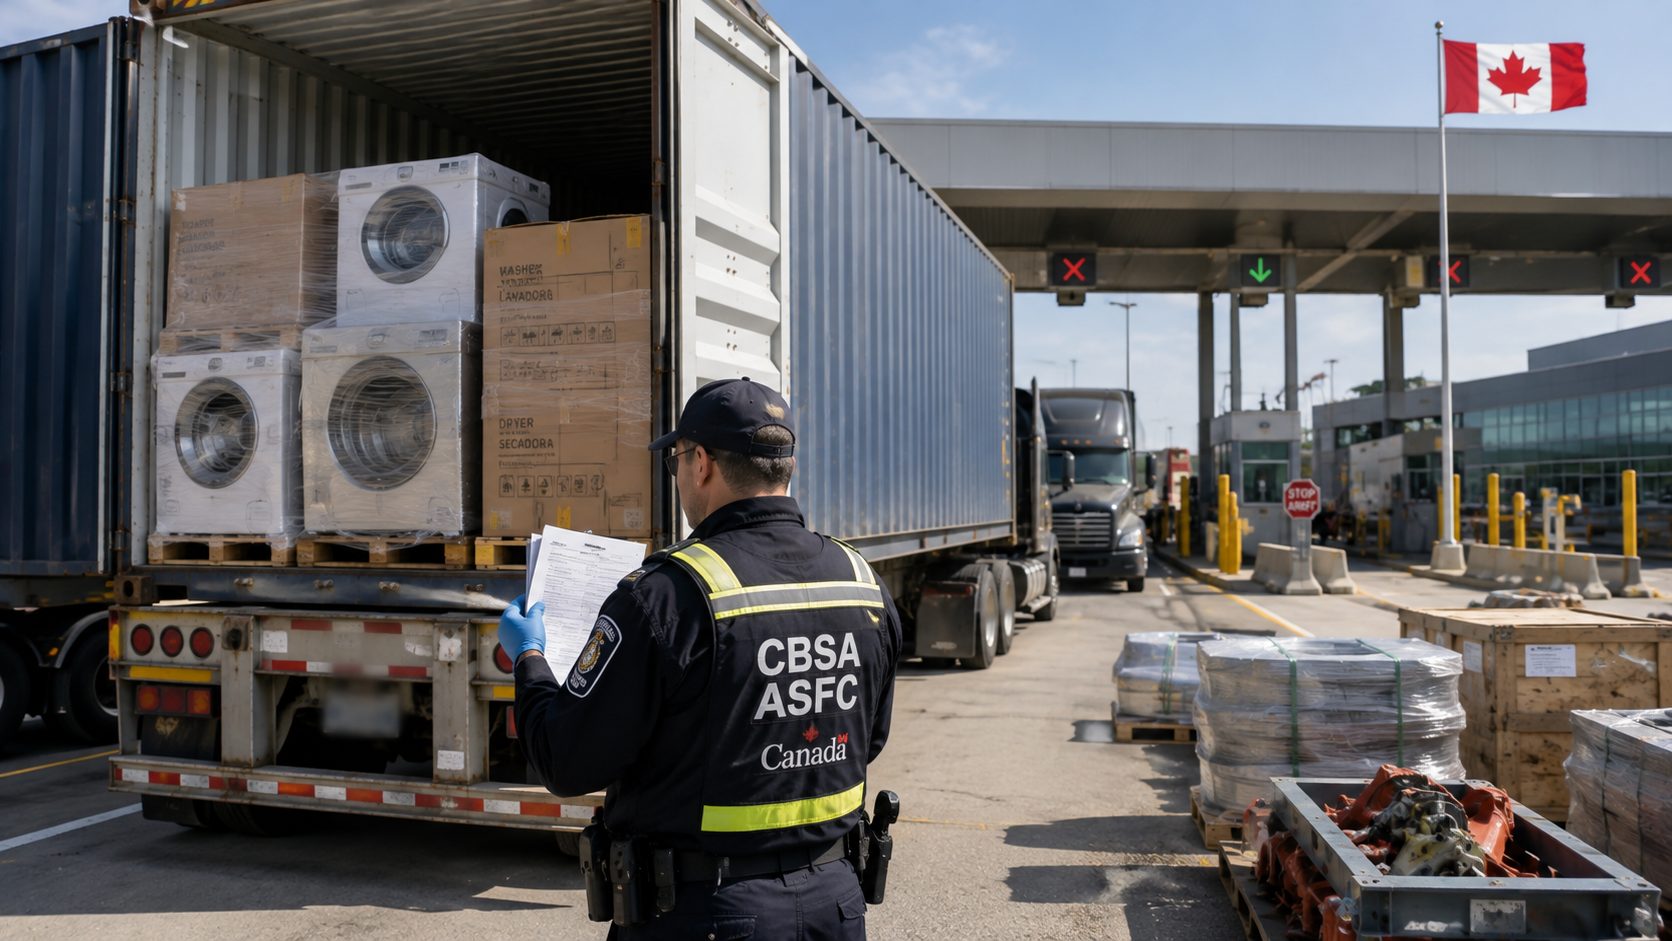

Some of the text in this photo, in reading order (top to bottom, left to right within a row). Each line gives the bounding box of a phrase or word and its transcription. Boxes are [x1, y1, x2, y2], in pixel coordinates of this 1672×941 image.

[499, 417, 534, 429] DRYER
[499, 438, 554, 449] SECADORA
[1288, 487, 1316, 499] STOP
[757, 632, 861, 676] CBSA
[753, 674, 858, 720] ASFC
[761, 737, 847, 771] Canada
